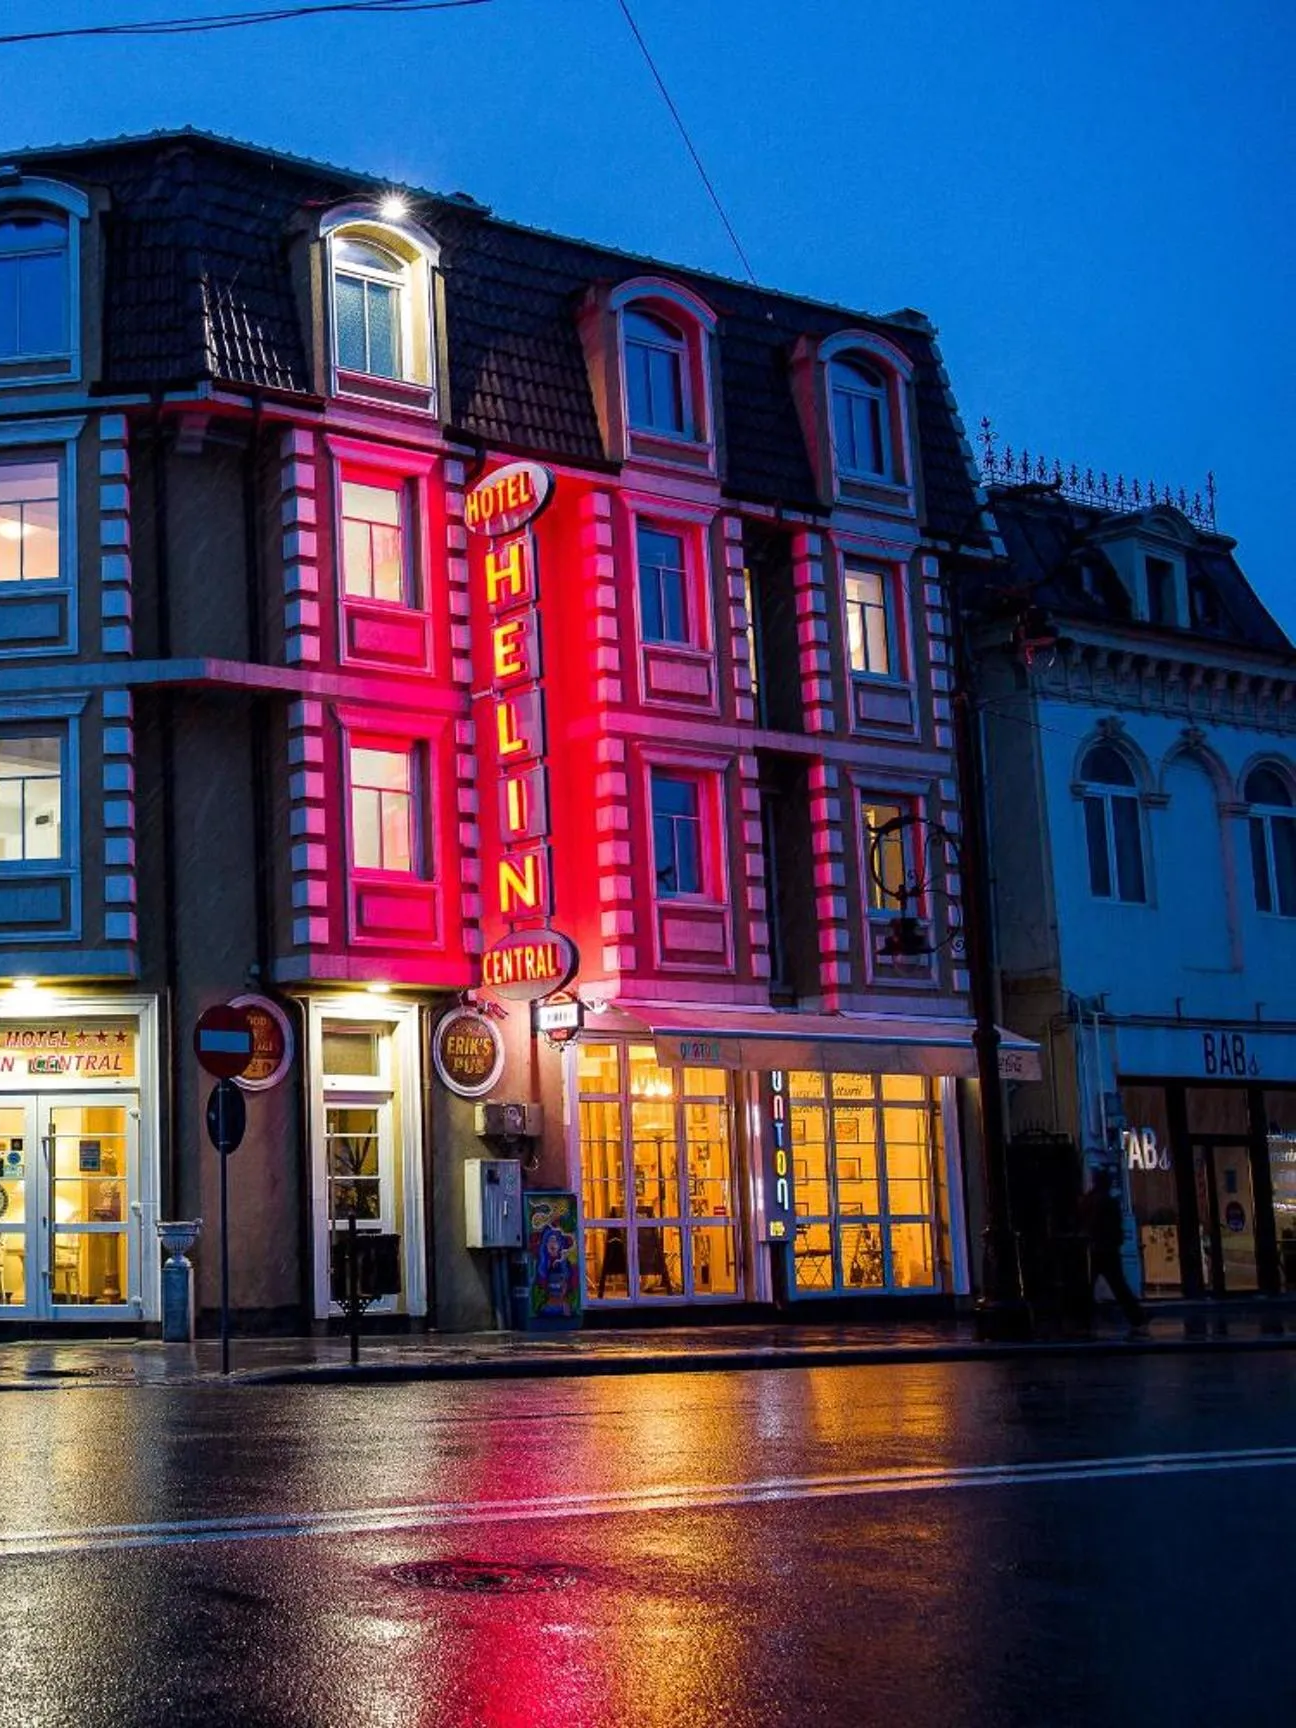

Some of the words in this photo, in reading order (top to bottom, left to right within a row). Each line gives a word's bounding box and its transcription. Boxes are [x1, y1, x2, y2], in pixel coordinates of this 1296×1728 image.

[466, 471, 532, 525] HOTEL
[484, 542, 540, 913] HELIN
[482, 943, 559, 984] CENTRAL
[6, 1030, 69, 1047] HOTEL
[447, 1036, 492, 1056] ERIK'S
[32, 1053, 124, 1071] CENTRAL
[453, 1057, 486, 1074] PUB
